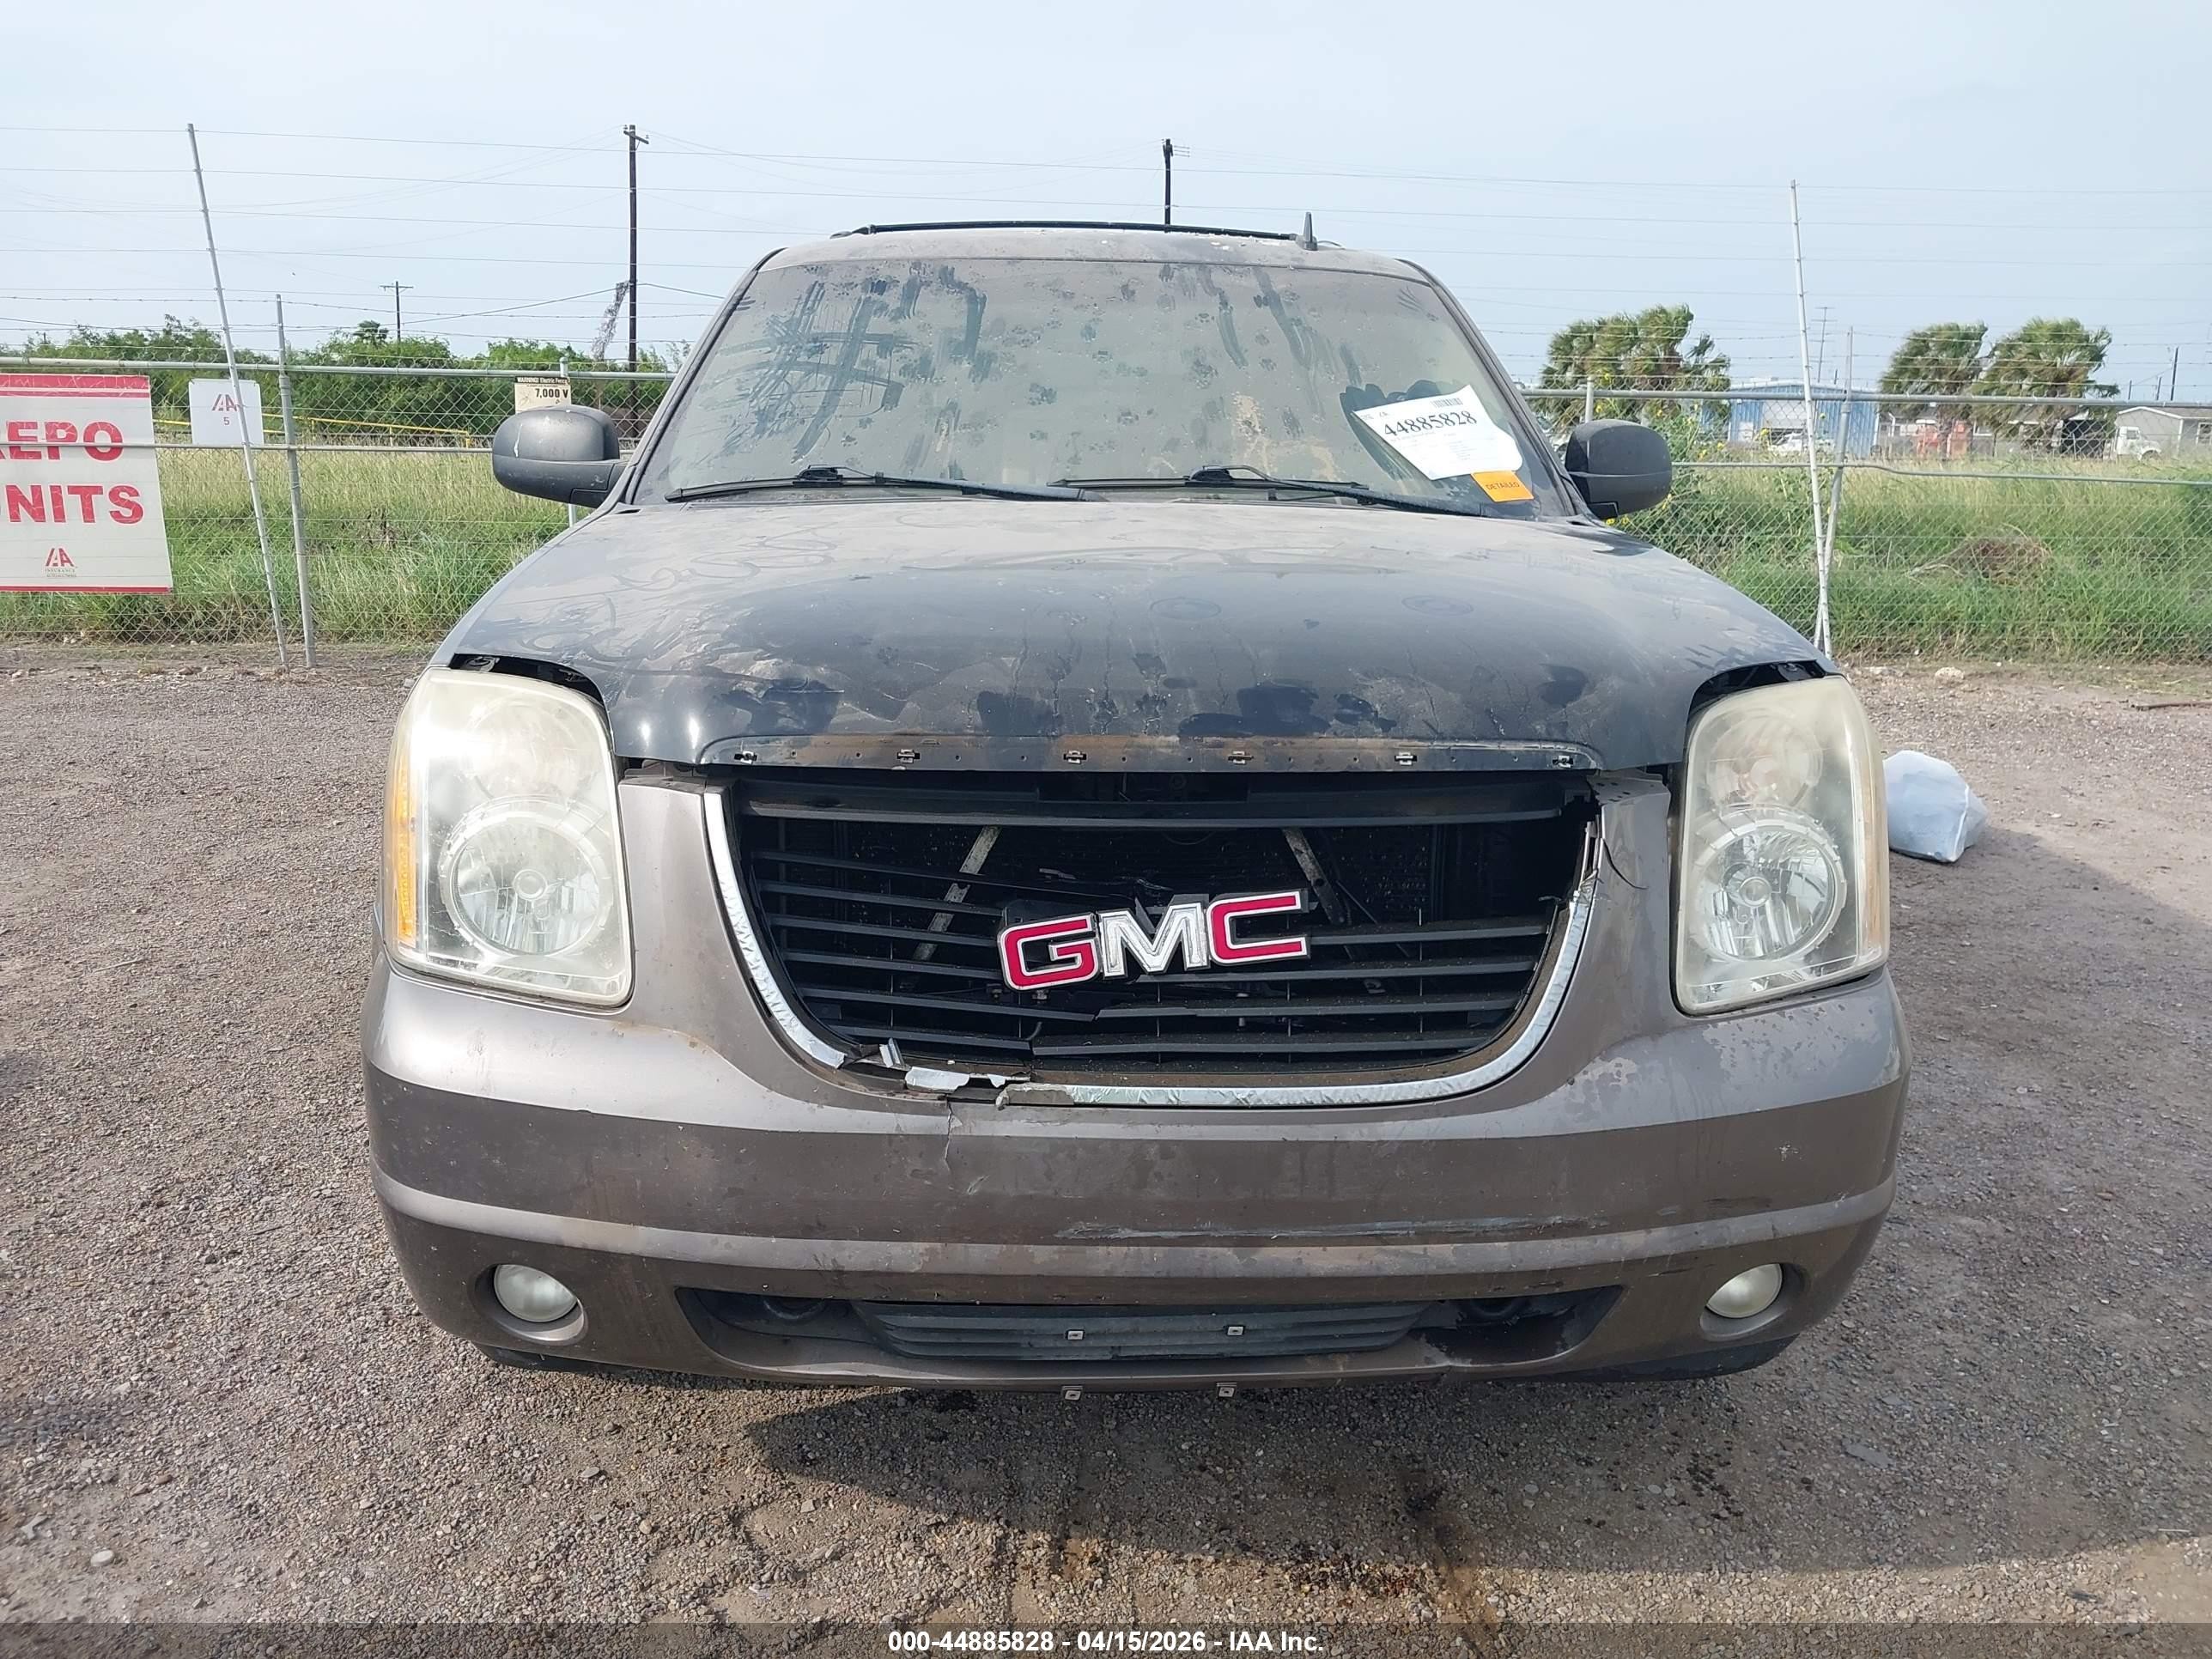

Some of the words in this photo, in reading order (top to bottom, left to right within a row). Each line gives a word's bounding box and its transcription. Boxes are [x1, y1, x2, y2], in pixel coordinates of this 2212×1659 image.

[535, 388, 561, 398] 7,000
[562, 389, 568, 398] V
[223, 416, 230, 426] 5
[1384, 410, 1478, 436] 44885828
[0, 484, 144, 525] NITS
[997, 889, 1310, 991] GMC
